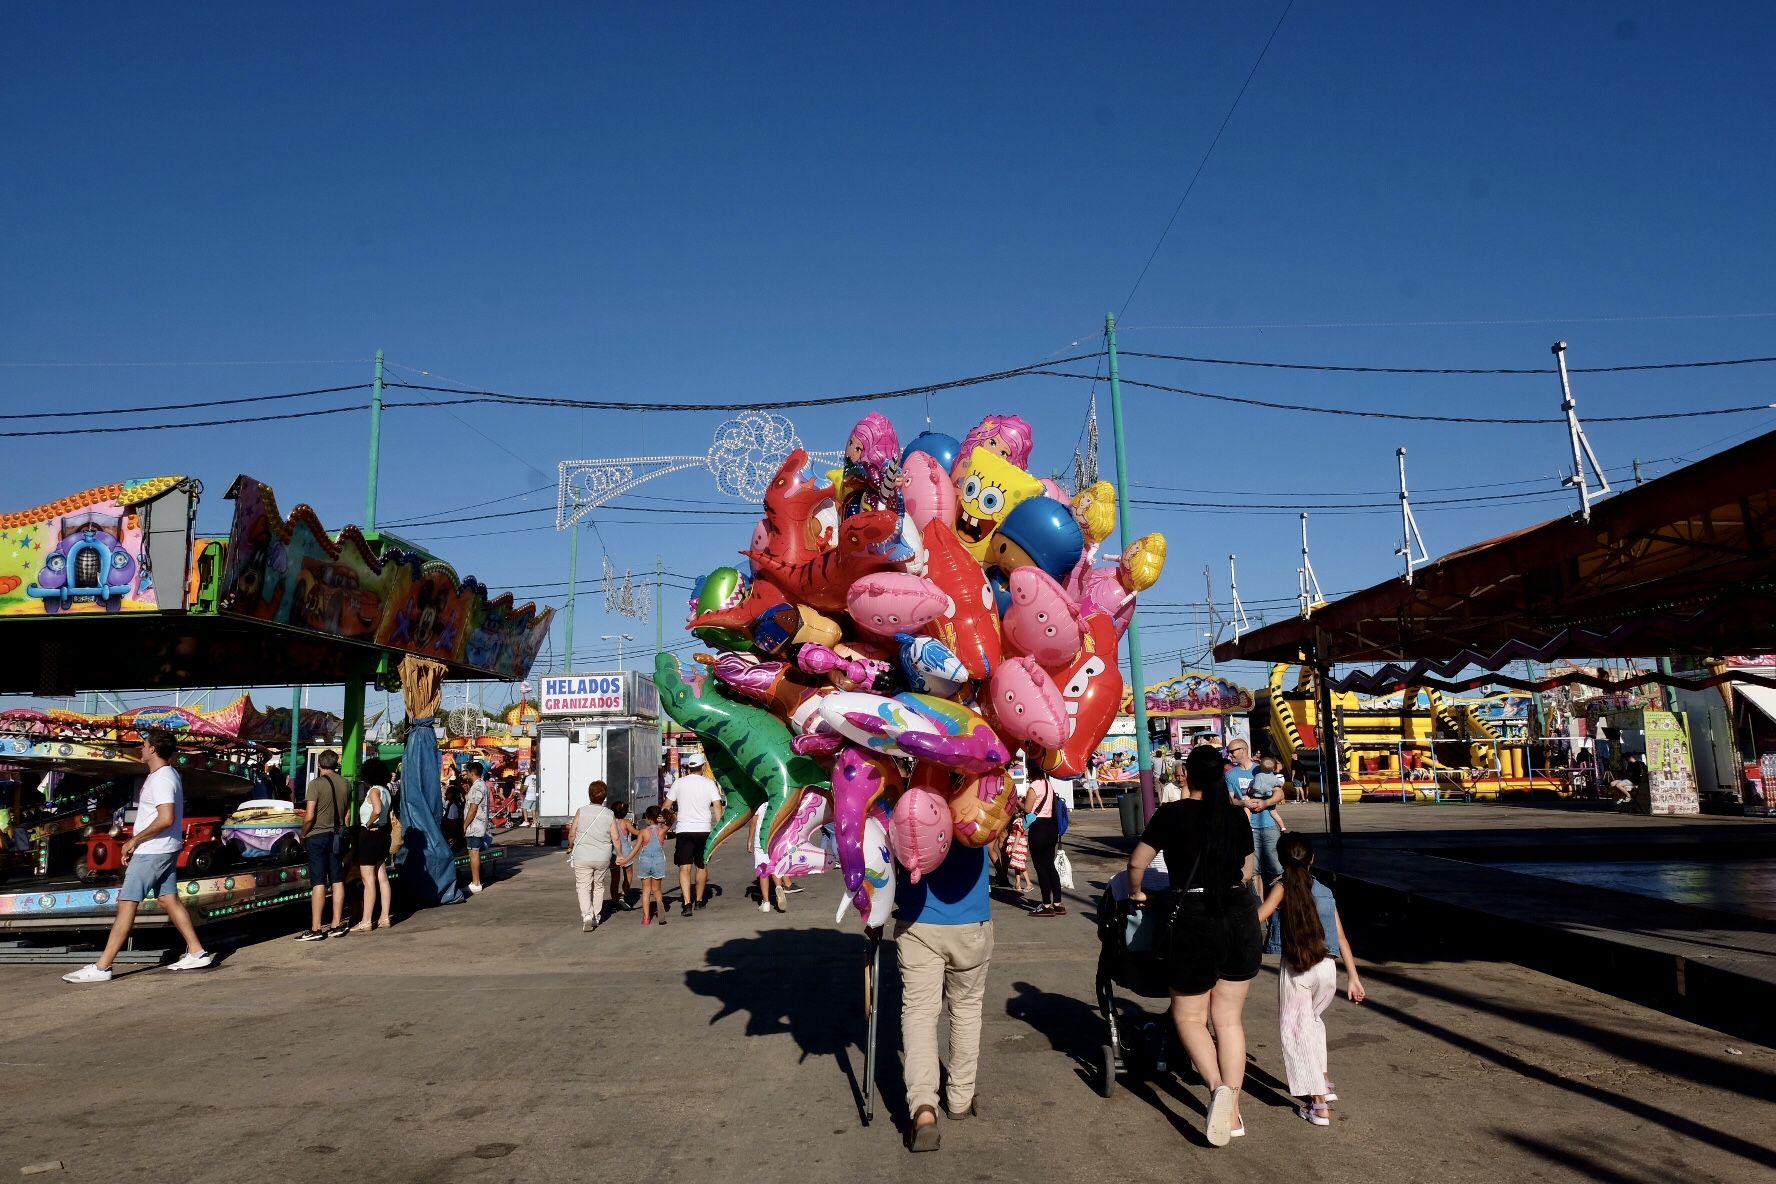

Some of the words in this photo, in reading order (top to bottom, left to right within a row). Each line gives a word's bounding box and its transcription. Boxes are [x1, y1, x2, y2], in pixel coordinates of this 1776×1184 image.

[547, 677, 620, 695] HELADOS
[545, 697, 620, 710] GRANIZADOS
[254, 828, 282, 837] NEMO
